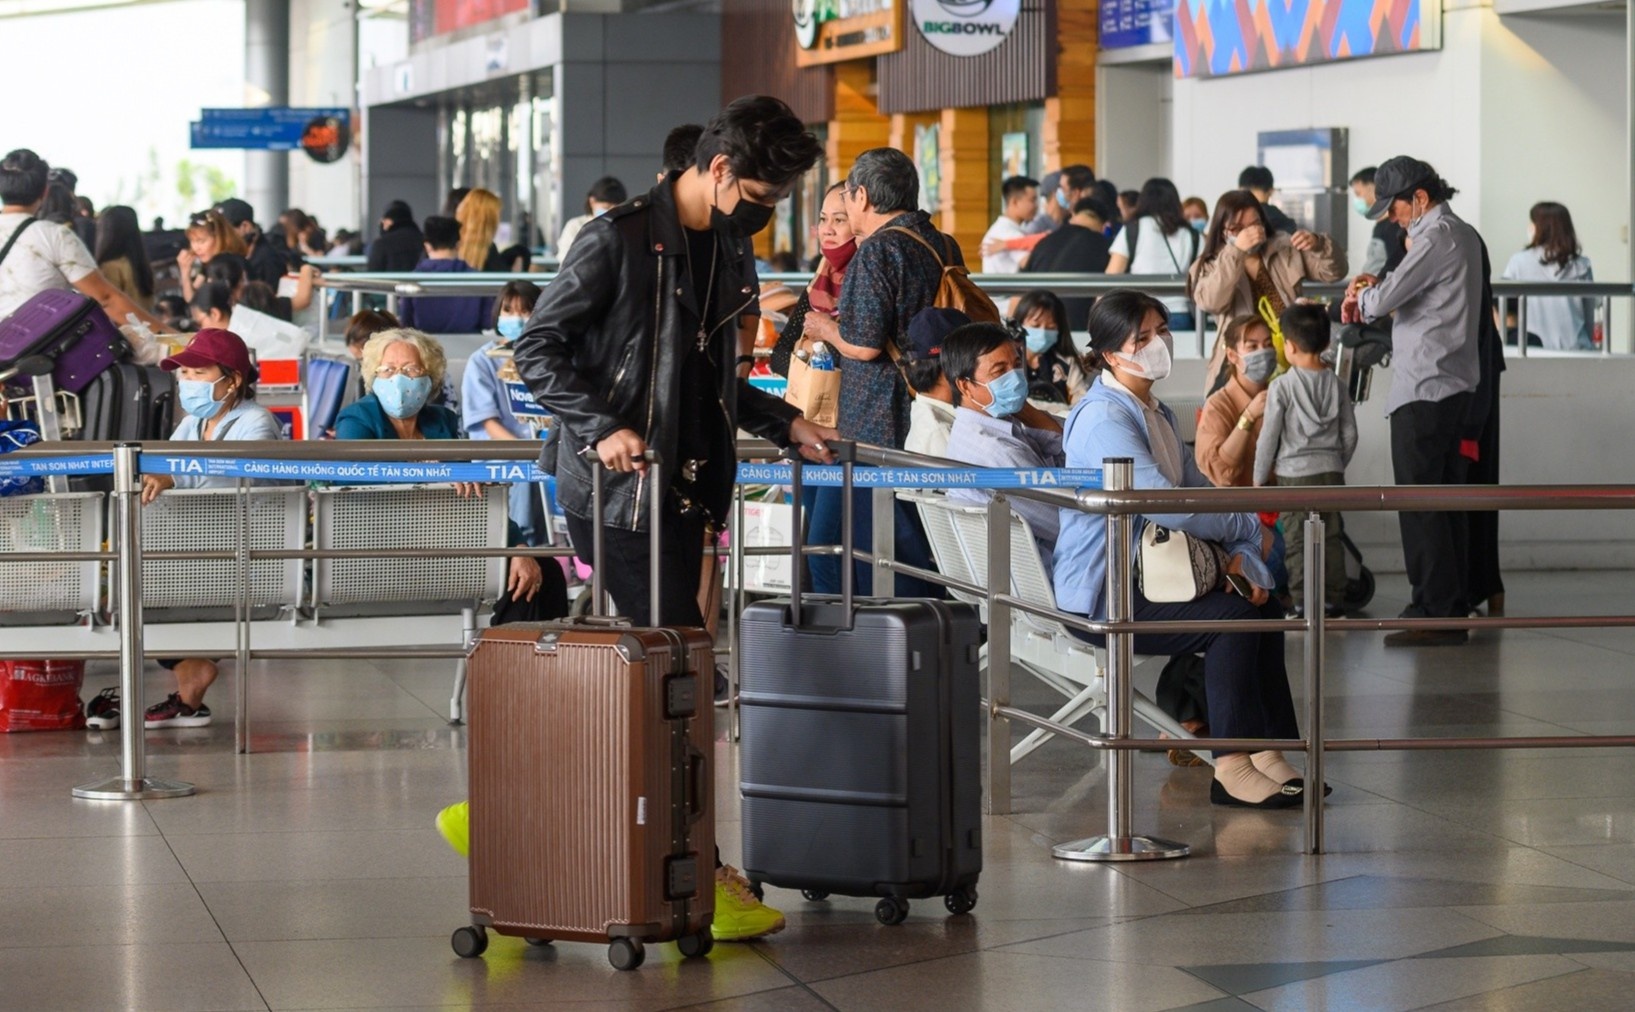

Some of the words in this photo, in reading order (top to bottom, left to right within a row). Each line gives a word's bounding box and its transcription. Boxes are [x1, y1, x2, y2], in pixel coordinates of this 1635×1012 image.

[923, 21, 1005, 36] BIGBOWL
[31, 463, 47, 471] TAN
[49, 462, 67, 470] SON
[68, 460, 89, 469] NHAT
[166, 458, 203, 473] TIA
[301, 464, 335, 475] KHÔNG
[381, 465, 400, 477] TÂN
[402, 467, 423, 477] SƠN
[485, 465, 525, 479] TIA
[897, 471, 918, 483] TÂN
[1014, 470, 1057, 485] TIA
